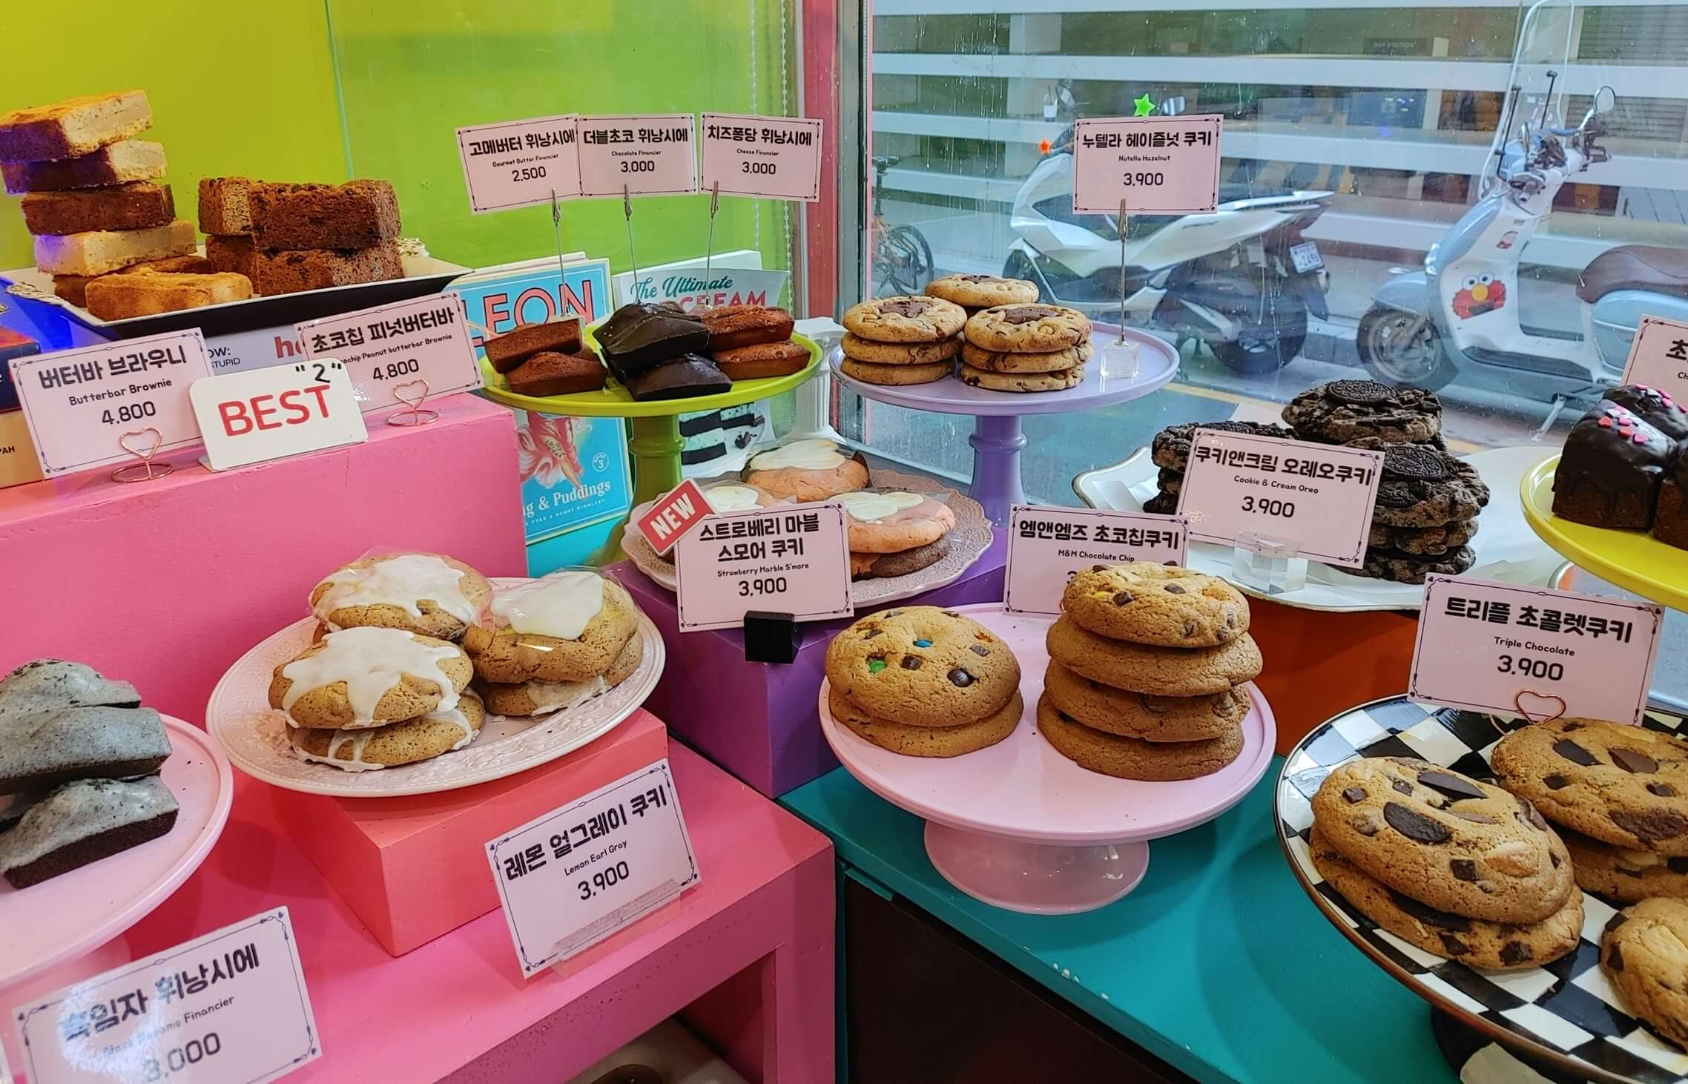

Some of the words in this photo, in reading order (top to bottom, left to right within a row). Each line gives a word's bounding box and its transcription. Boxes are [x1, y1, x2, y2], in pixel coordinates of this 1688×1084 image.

[468, 136, 522, 156] 고메버터
[525, 128, 576, 149] 휘낭시에
[583, 128, 635, 144] 더블초코
[638, 128, 688, 143] 휘낭시에
[708, 124, 758, 142] 치즈퐁당
[761, 128, 812, 146] 휘낭시에
[1082, 133, 1122, 148] 누텔라
[1126, 132, 1179, 148] 헤이즐넛
[1184, 131, 1212, 146] 쿠키
[492, 159, 516, 168] Gourmet
[516, 156, 534, 164] Butter
[536, 154, 558, 162] Financier
[630, 277, 658, 299] The
[662, 276, 733, 298] Ultimate
[312, 326, 365, 354] 초코칩
[368, 306, 455, 340] 피넛버터바
[362, 348, 387, 360] Peanut
[388, 341, 424, 354] butterbar
[424, 334, 452, 345] Brownie
[38, 361, 104, 389] 버터바
[108, 346, 186, 376] 브라우니
[68, 388, 126, 406] Butterbar
[128, 378, 172, 394] Brownie
[218, 384, 330, 437] BEST
[1195, 446, 1278, 472] 쿠키앤크림
[1281, 458, 1372, 486] 오레오쿠키
[538, 496, 550, 510] &
[553, 480, 611, 506] Puddings
[1234, 475, 1260, 486] Cookie
[1262, 479, 1268, 487] &
[1271, 480, 1296, 490] Cream
[1298, 485, 1319, 494] Oreo
[650, 492, 697, 541] NEW
[700, 518, 780, 542] 스트로베리
[786, 513, 820, 533] 마블
[1020, 520, 1088, 541] 엠앤엠즈
[1093, 524, 1179, 550] 초코칩쿠키
[718, 542, 766, 562] 스모어
[772, 538, 804, 558] 쿠키
[1058, 550, 1078, 558] M&M
[1079, 551, 1117, 561] Chocolate
[1118, 554, 1135, 562] Chip
[718, 568, 758, 578] Strawberry
[760, 566, 784, 574] Marble
[786, 562, 810, 571] S'more
[1444, 597, 1510, 624] 트리플
[1516, 606, 1633, 643] 초콜렛쿠키
[1494, 636, 1522, 649] Triple
[1525, 640, 1576, 656] Chocolate
[504, 843, 547, 881] 레몬
[550, 804, 628, 859] 얼그레이
[630, 784, 667, 818] 쿠키
[564, 860, 590, 876] Lemon
[590, 848, 608, 863] Earl
[608, 840, 628, 854] Gray
[155, 943, 260, 1004] 휘낭시에
[184, 996, 235, 1024] Financier
